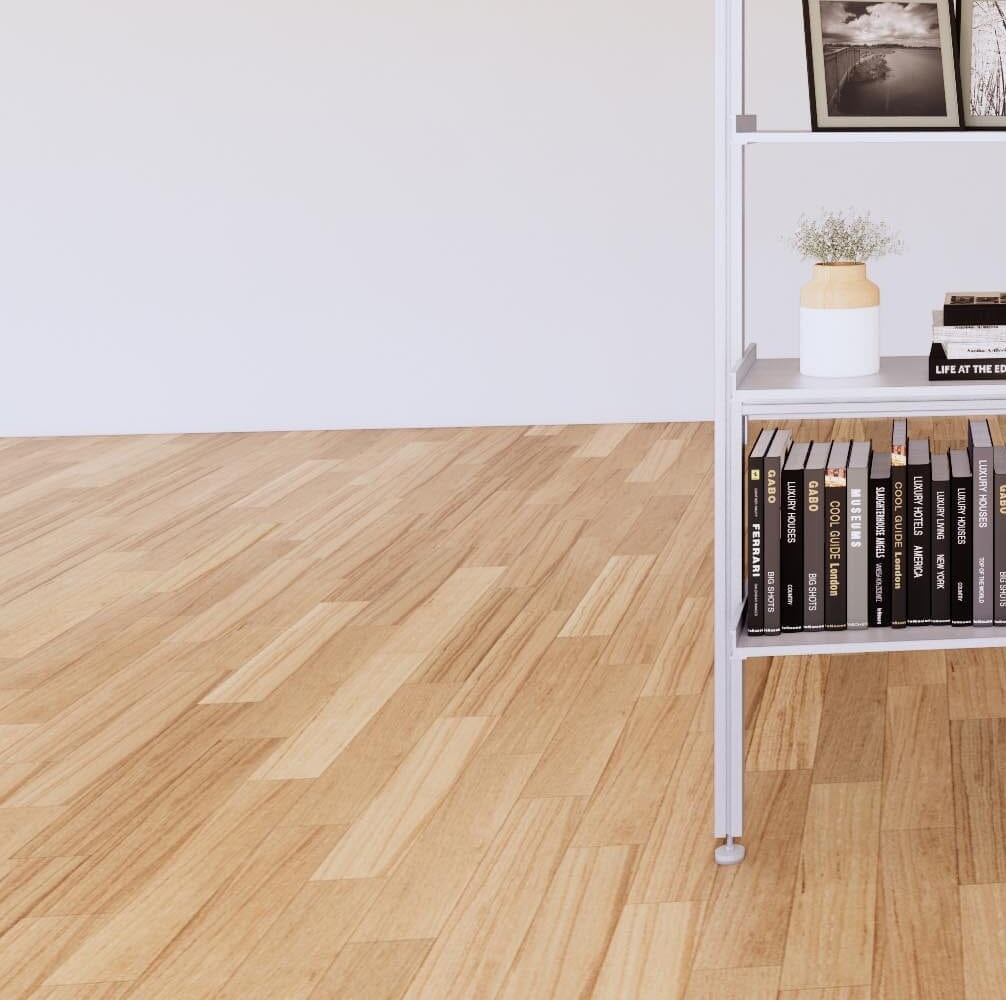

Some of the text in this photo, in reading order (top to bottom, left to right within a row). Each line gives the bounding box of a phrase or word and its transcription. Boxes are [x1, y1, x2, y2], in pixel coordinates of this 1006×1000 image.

[935, 364, 957, 375] LIFE
[958, 364, 971, 374] AT
[972, 363, 993, 374] THE
[767, 469, 777, 504] GABO
[787, 481, 796, 543] LUXURY HOUSES
[808, 480, 819, 512] GABO
[875, 486, 886, 536] SLAUGHTERHOUSE
[978, 459, 987, 528] LUXURY HOUSES
[850, 488, 862, 548] MUSEUMS
[893, 481, 903, 590] COOL GUIDE London
[913, 476, 923, 578] LUXURY HOTELS AMERICA
[936, 491, 945, 589] LUXURY LIVING NEW YORK
[957, 488, 966, 545] LUXURY HOUSES
[752, 523, 761, 578] FERRARI
[829, 500, 841, 597] COOL GUIDE London
[875, 537, 885, 559] ANGELS
[767, 571, 775, 613] BIG SHOTS
[808, 573, 817, 611] BIG SHOTS
